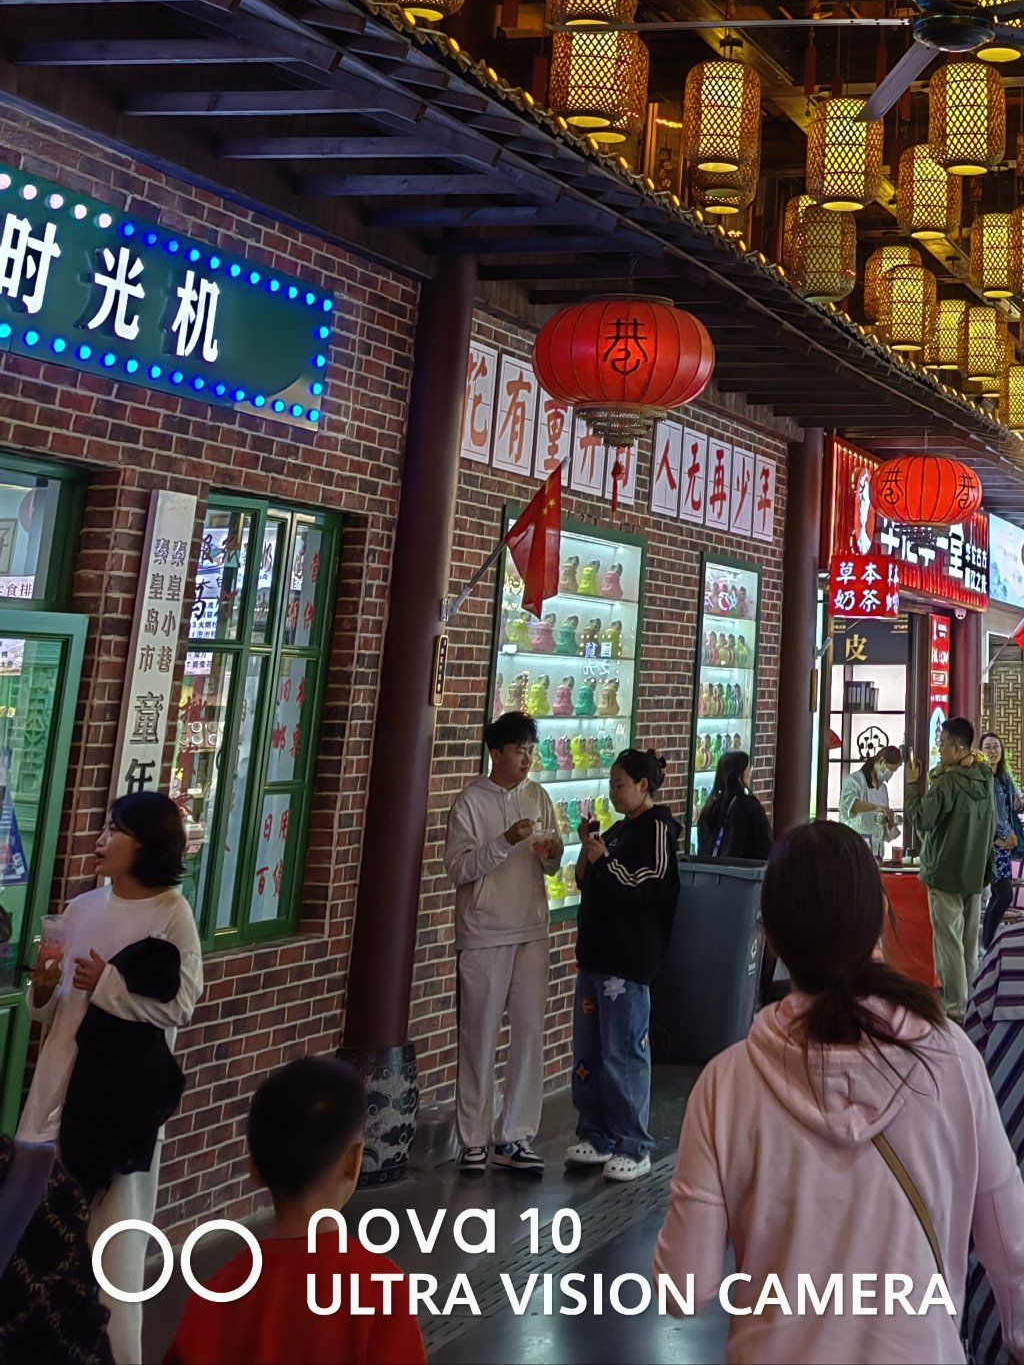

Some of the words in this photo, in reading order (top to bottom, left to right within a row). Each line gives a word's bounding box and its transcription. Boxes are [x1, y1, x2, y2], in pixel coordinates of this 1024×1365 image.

[0, 212, 221, 363] 时光机
[655, 439, 772, 532] 人无再少年
[138, 538, 169, 672] 秦皇岛市
[157, 540, 188, 673] 秦皇小巷
[834, 589, 881, 612] 奶茶
[836, 562, 882, 585] 草本
